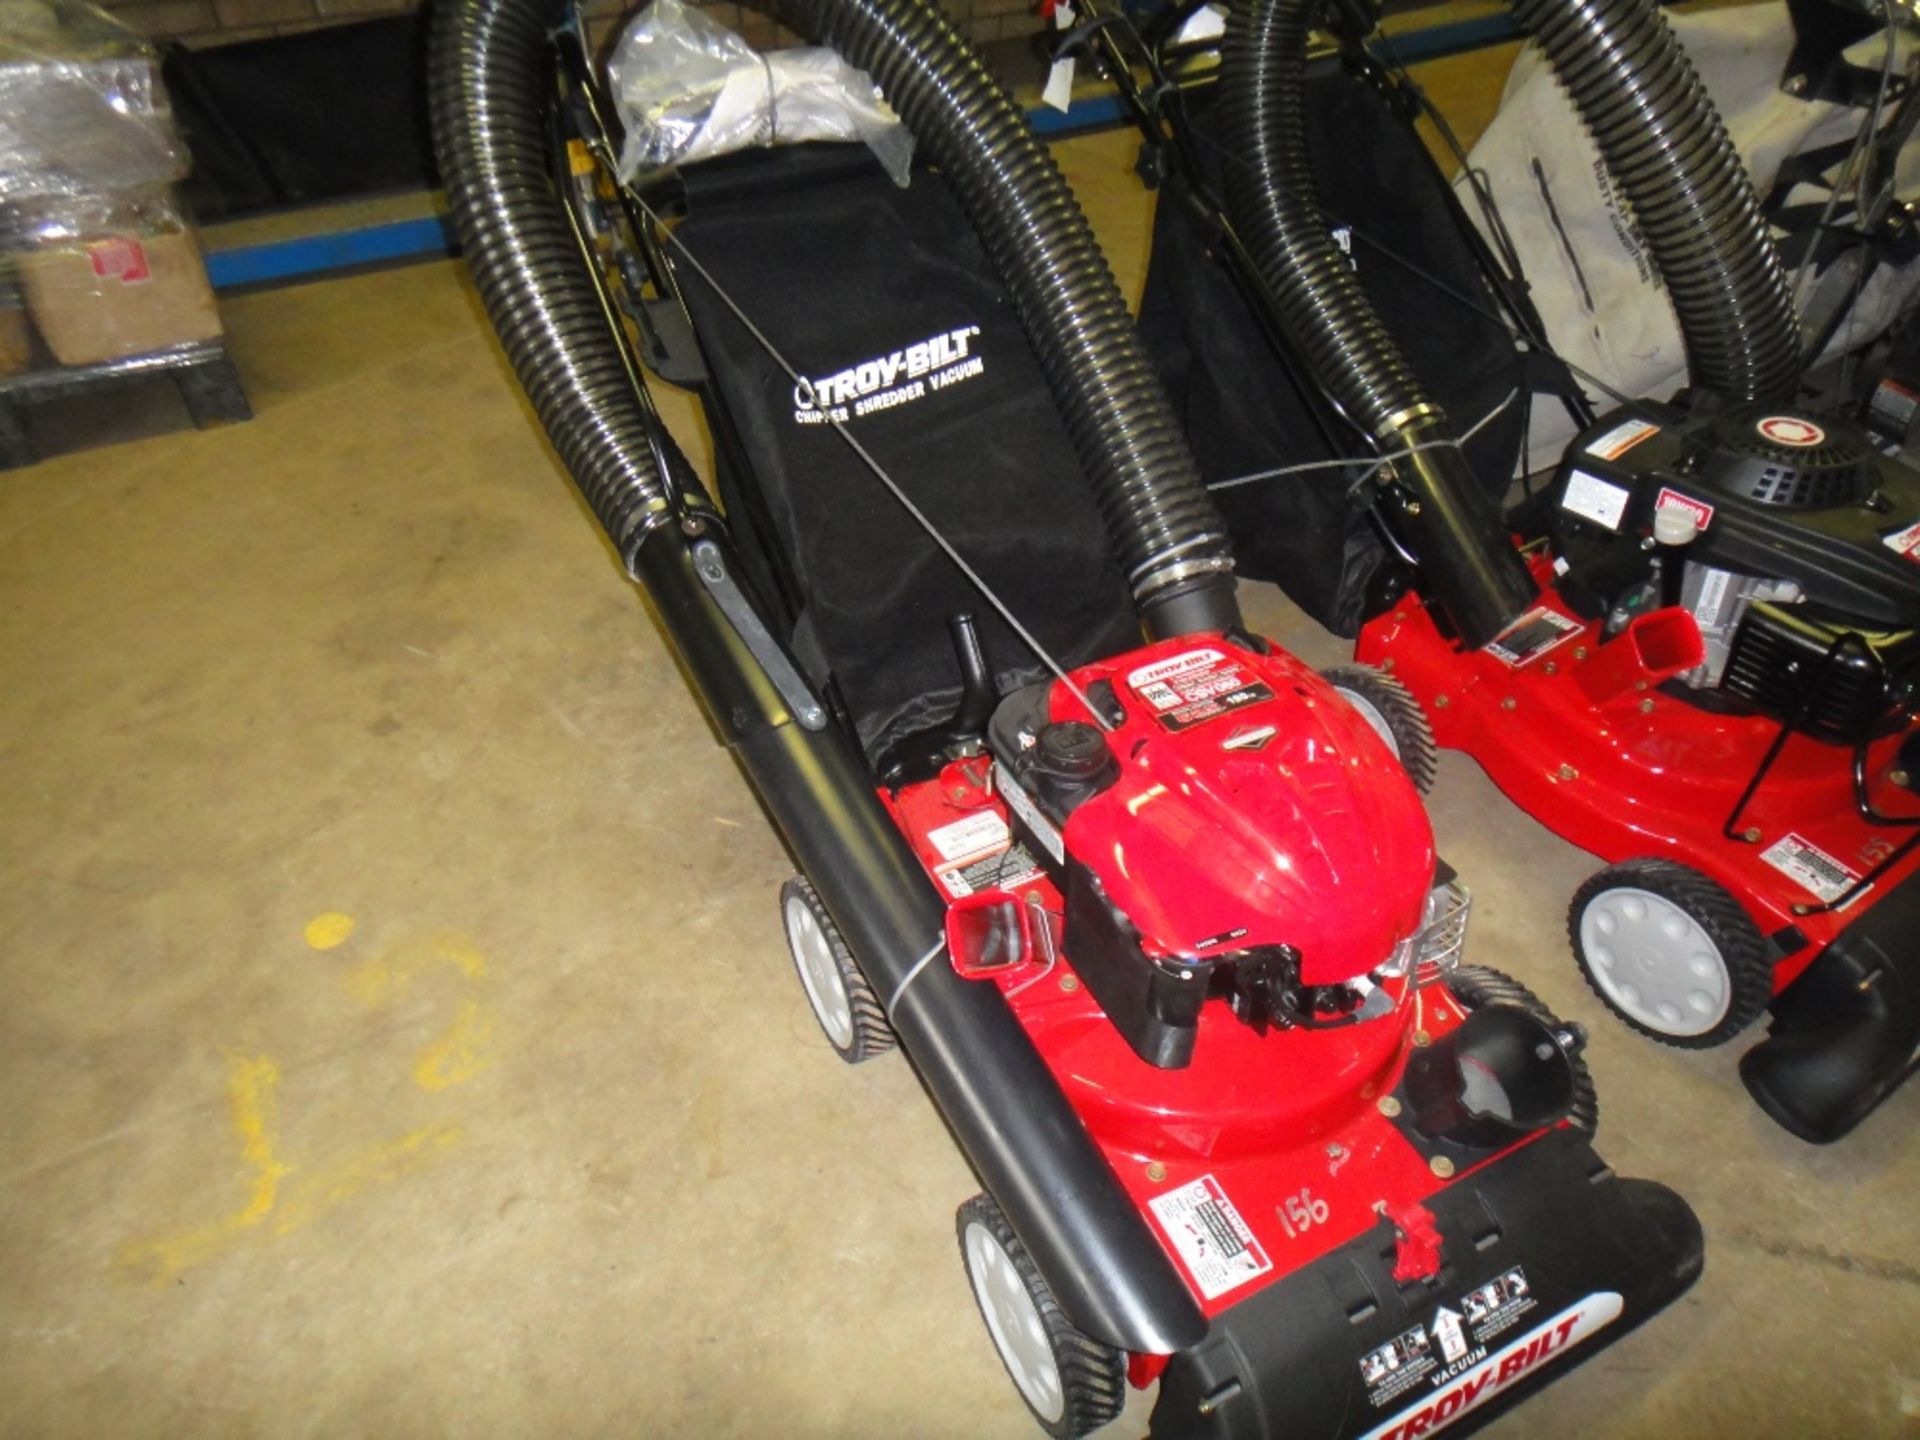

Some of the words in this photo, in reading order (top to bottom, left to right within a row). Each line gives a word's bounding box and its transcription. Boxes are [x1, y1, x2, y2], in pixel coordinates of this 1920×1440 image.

[813, 327, 971, 406] TROY-BILT
[855, 381, 926, 416] SHREDDER
[928, 356, 985, 391] VACUUM
[1275, 1187, 1329, 1239] 156
[1431, 1346, 1488, 1387] VACUUM
